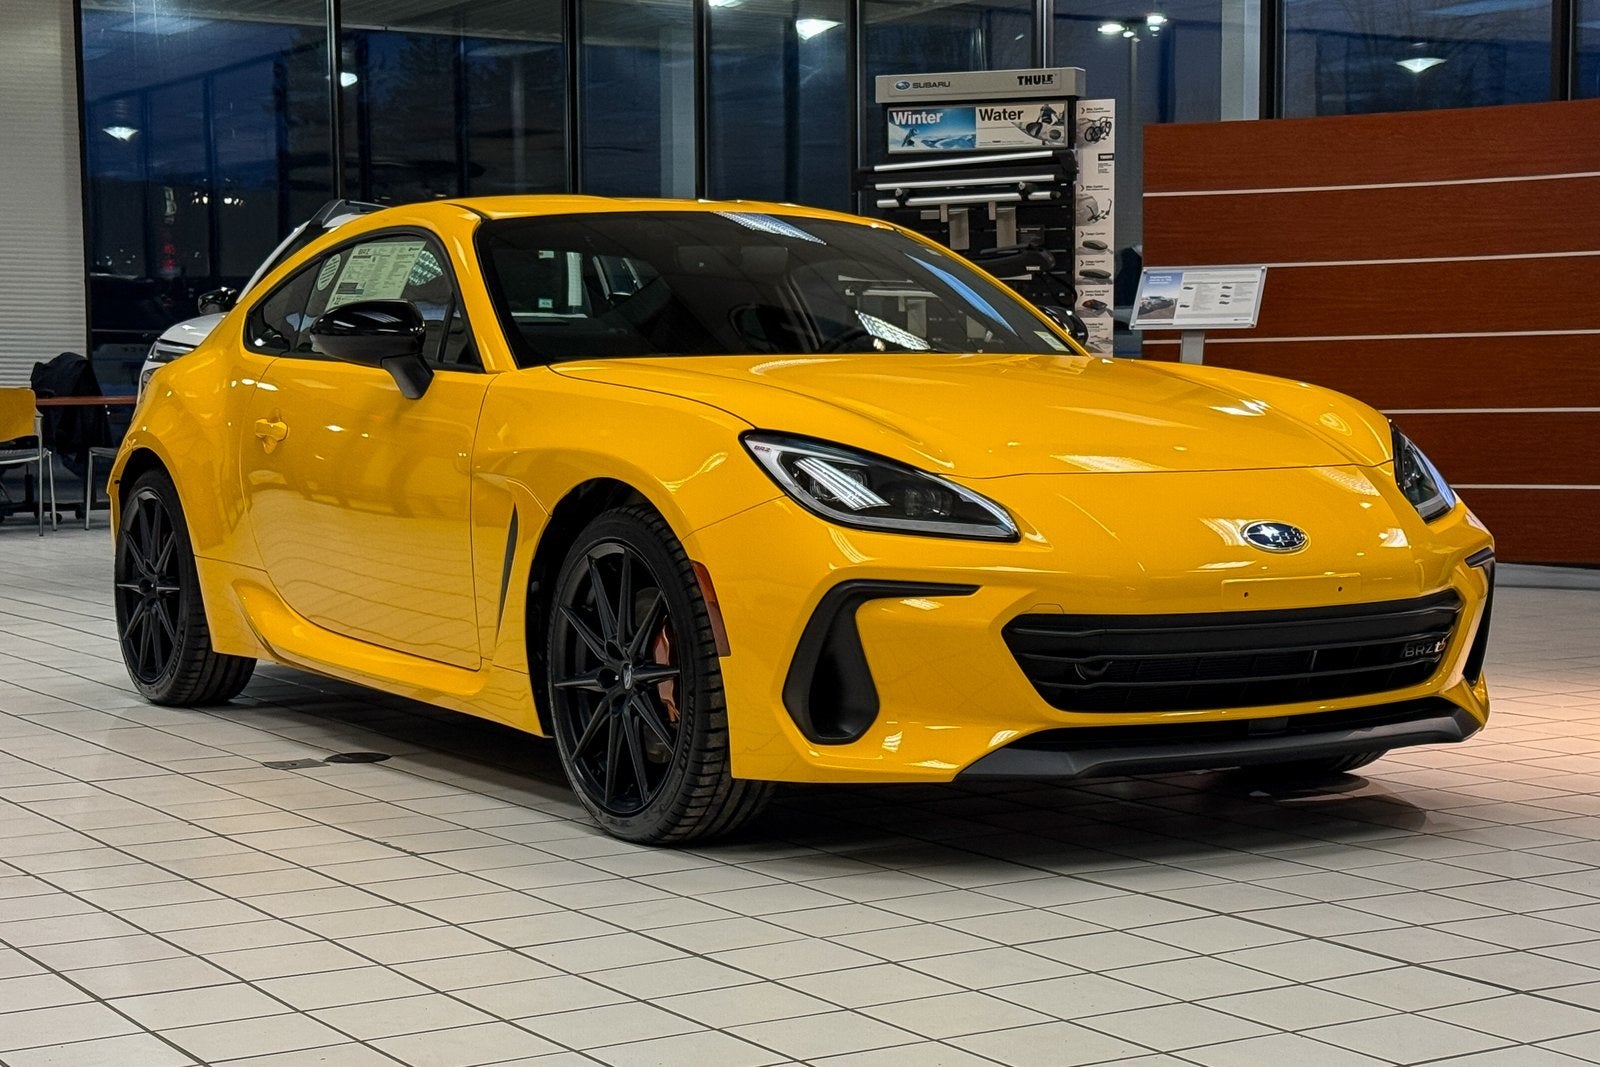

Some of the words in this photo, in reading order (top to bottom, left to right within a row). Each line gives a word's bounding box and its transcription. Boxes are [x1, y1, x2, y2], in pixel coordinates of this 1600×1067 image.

[912, 81, 951, 89] SUBARU
[1017, 74, 1053, 86] THULE
[892, 111, 944, 125] Winter
[978, 107, 1024, 122] Water
[1404, 642, 1433, 658] BRZ
